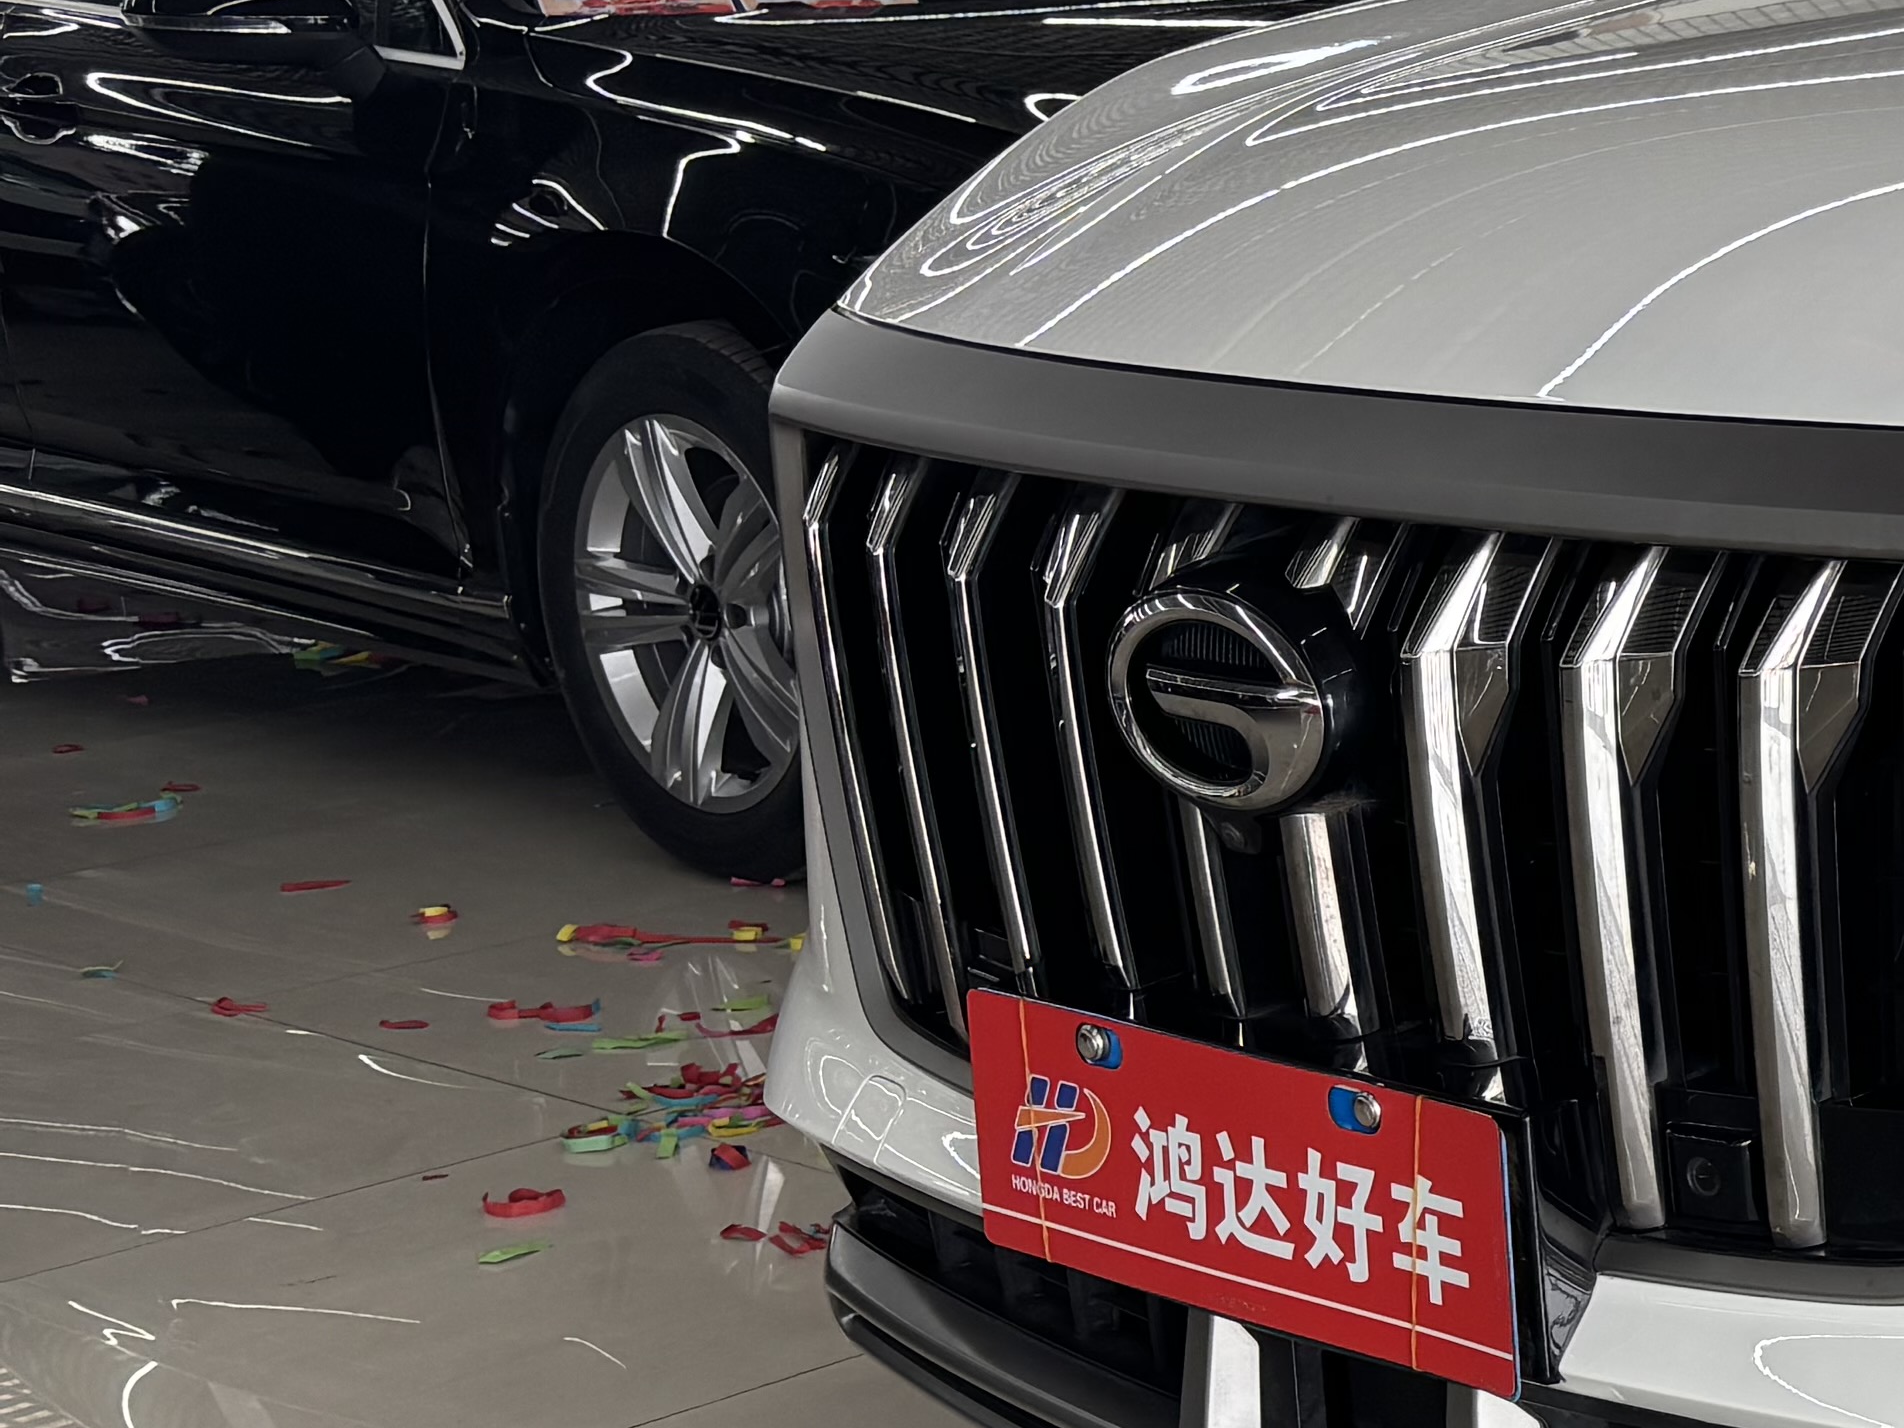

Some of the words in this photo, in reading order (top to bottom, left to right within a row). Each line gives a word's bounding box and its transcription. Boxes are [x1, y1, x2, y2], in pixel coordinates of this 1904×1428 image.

[1011, 1174, 1061, 1202] HONGDA
[1062, 1188, 1091, 1210] BEST
[1093, 1197, 1117, 1218] CAR
[1131, 1106, 1471, 1305] 鸿达好车
